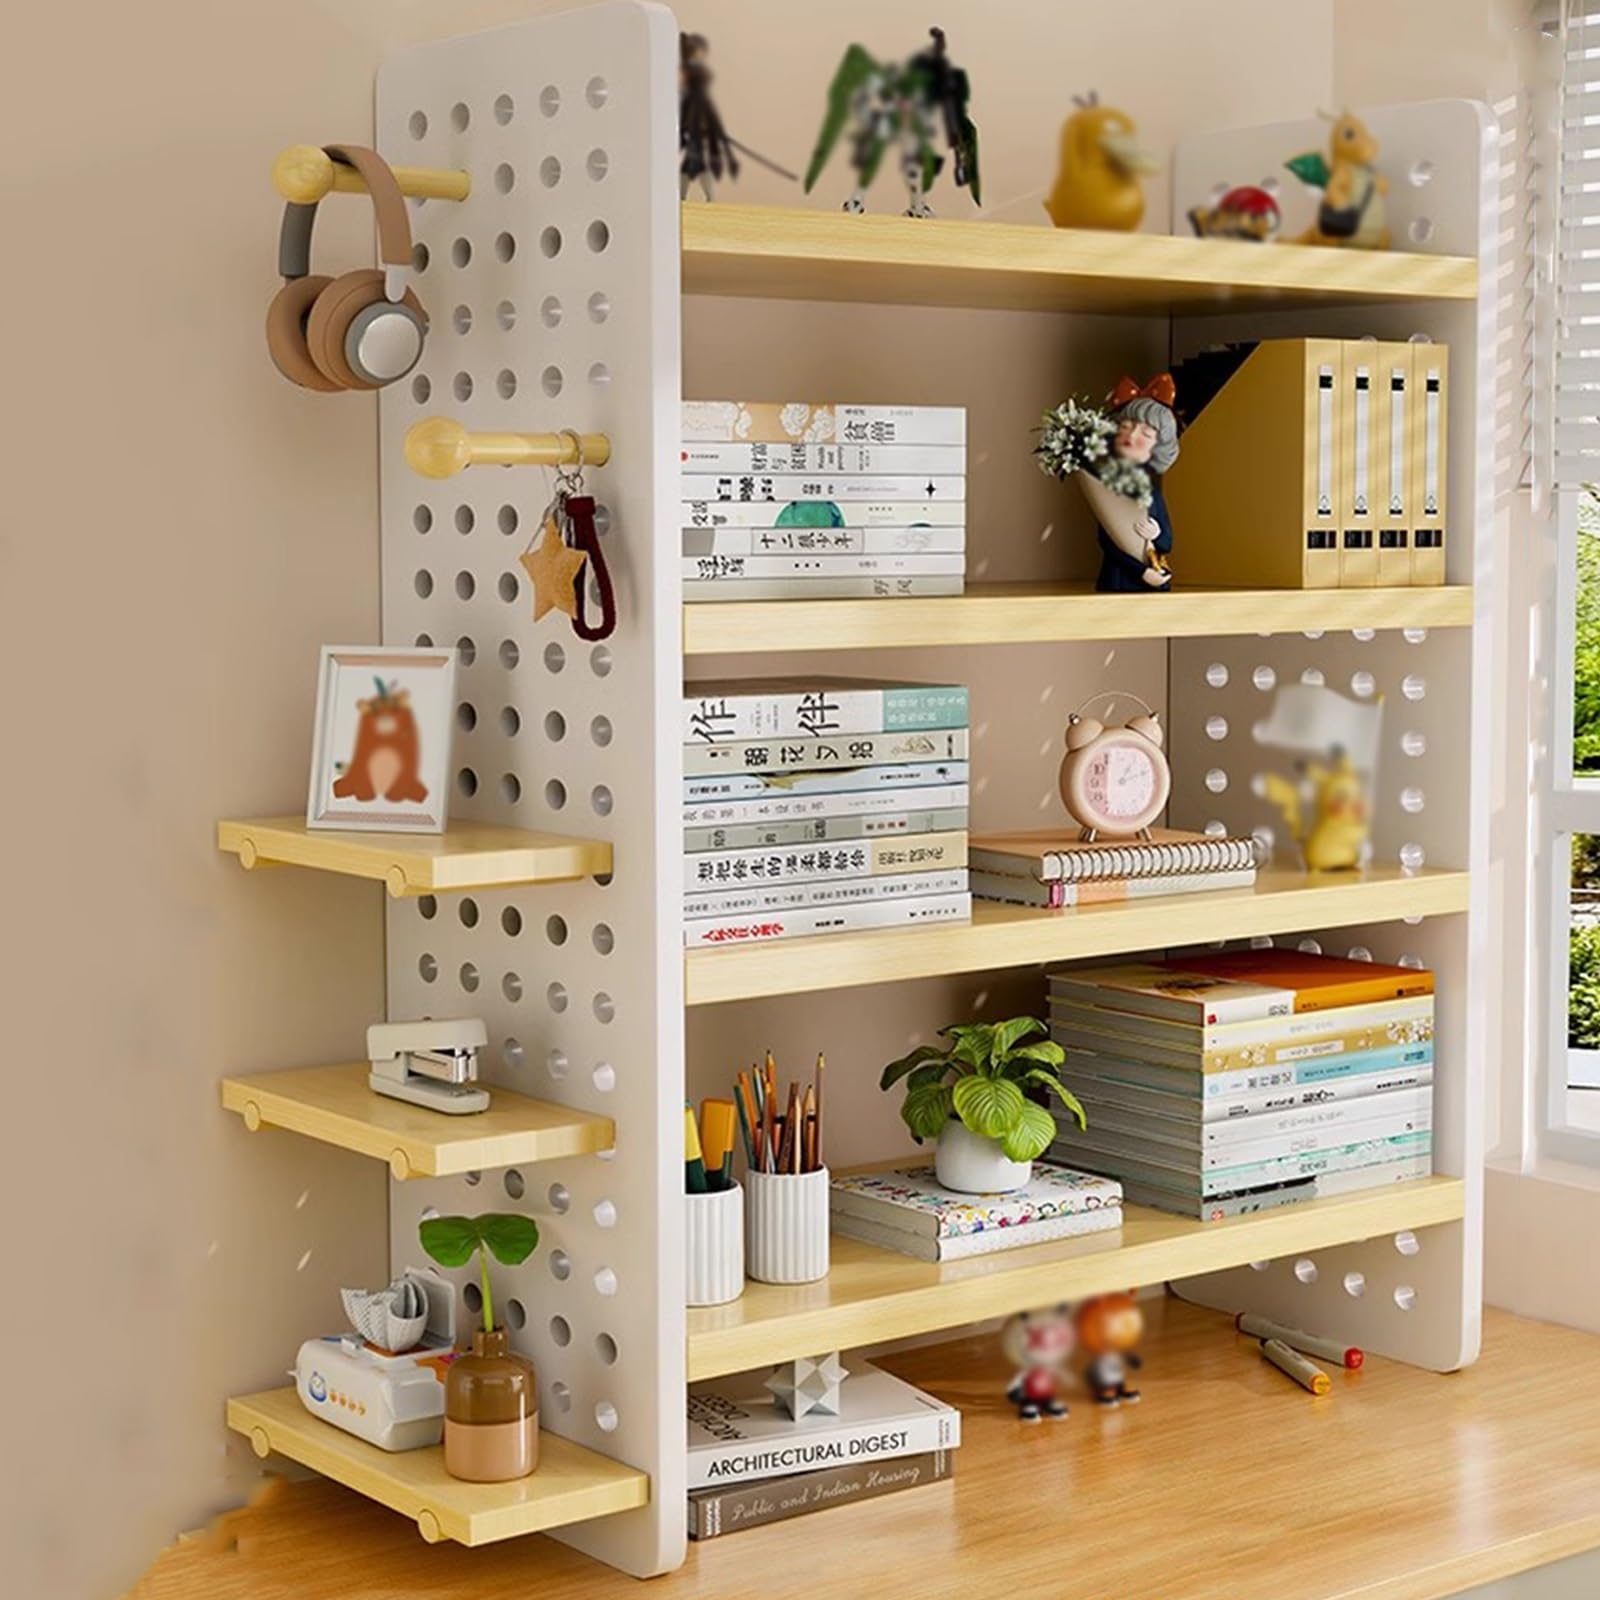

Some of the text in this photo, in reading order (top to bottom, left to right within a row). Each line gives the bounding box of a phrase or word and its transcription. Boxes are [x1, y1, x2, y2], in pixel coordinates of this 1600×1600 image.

[744, 741, 873, 766] 朝花夕拾
[708, 1442, 844, 1478] ARCHITECTURAL
[849, 1432, 908, 1456] DIGEST
[732, 1499, 775, 1521] Public
[866, 1467, 920, 1488] Housing
